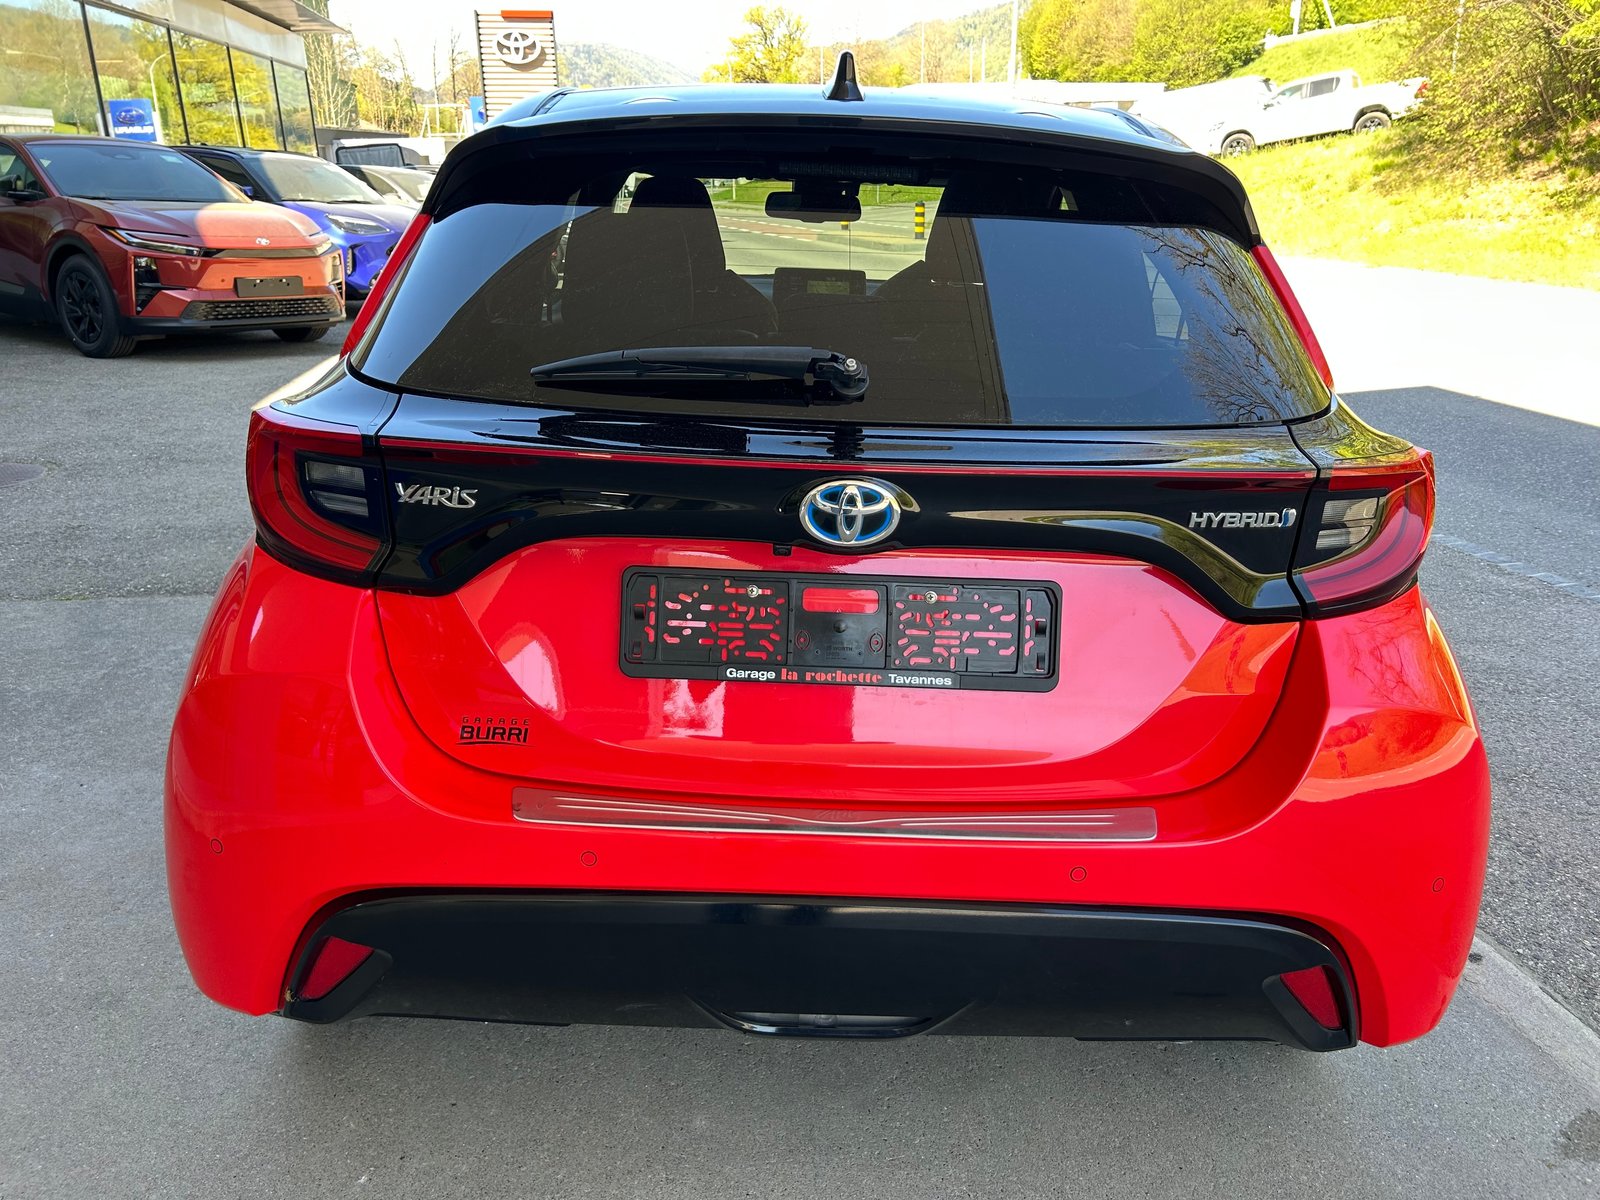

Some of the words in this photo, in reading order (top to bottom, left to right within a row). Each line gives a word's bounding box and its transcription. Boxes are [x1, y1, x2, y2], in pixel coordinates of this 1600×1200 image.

[1189, 512, 1281, 528] HYBRID
[726, 668, 776, 680] Garage
[781, 668, 798, 680] la
[805, 670, 882, 683] rochette
[888, 673, 952, 685] Tavannes
[462, 716, 529, 725] GARAGE
[460, 725, 529, 743] BURRI
